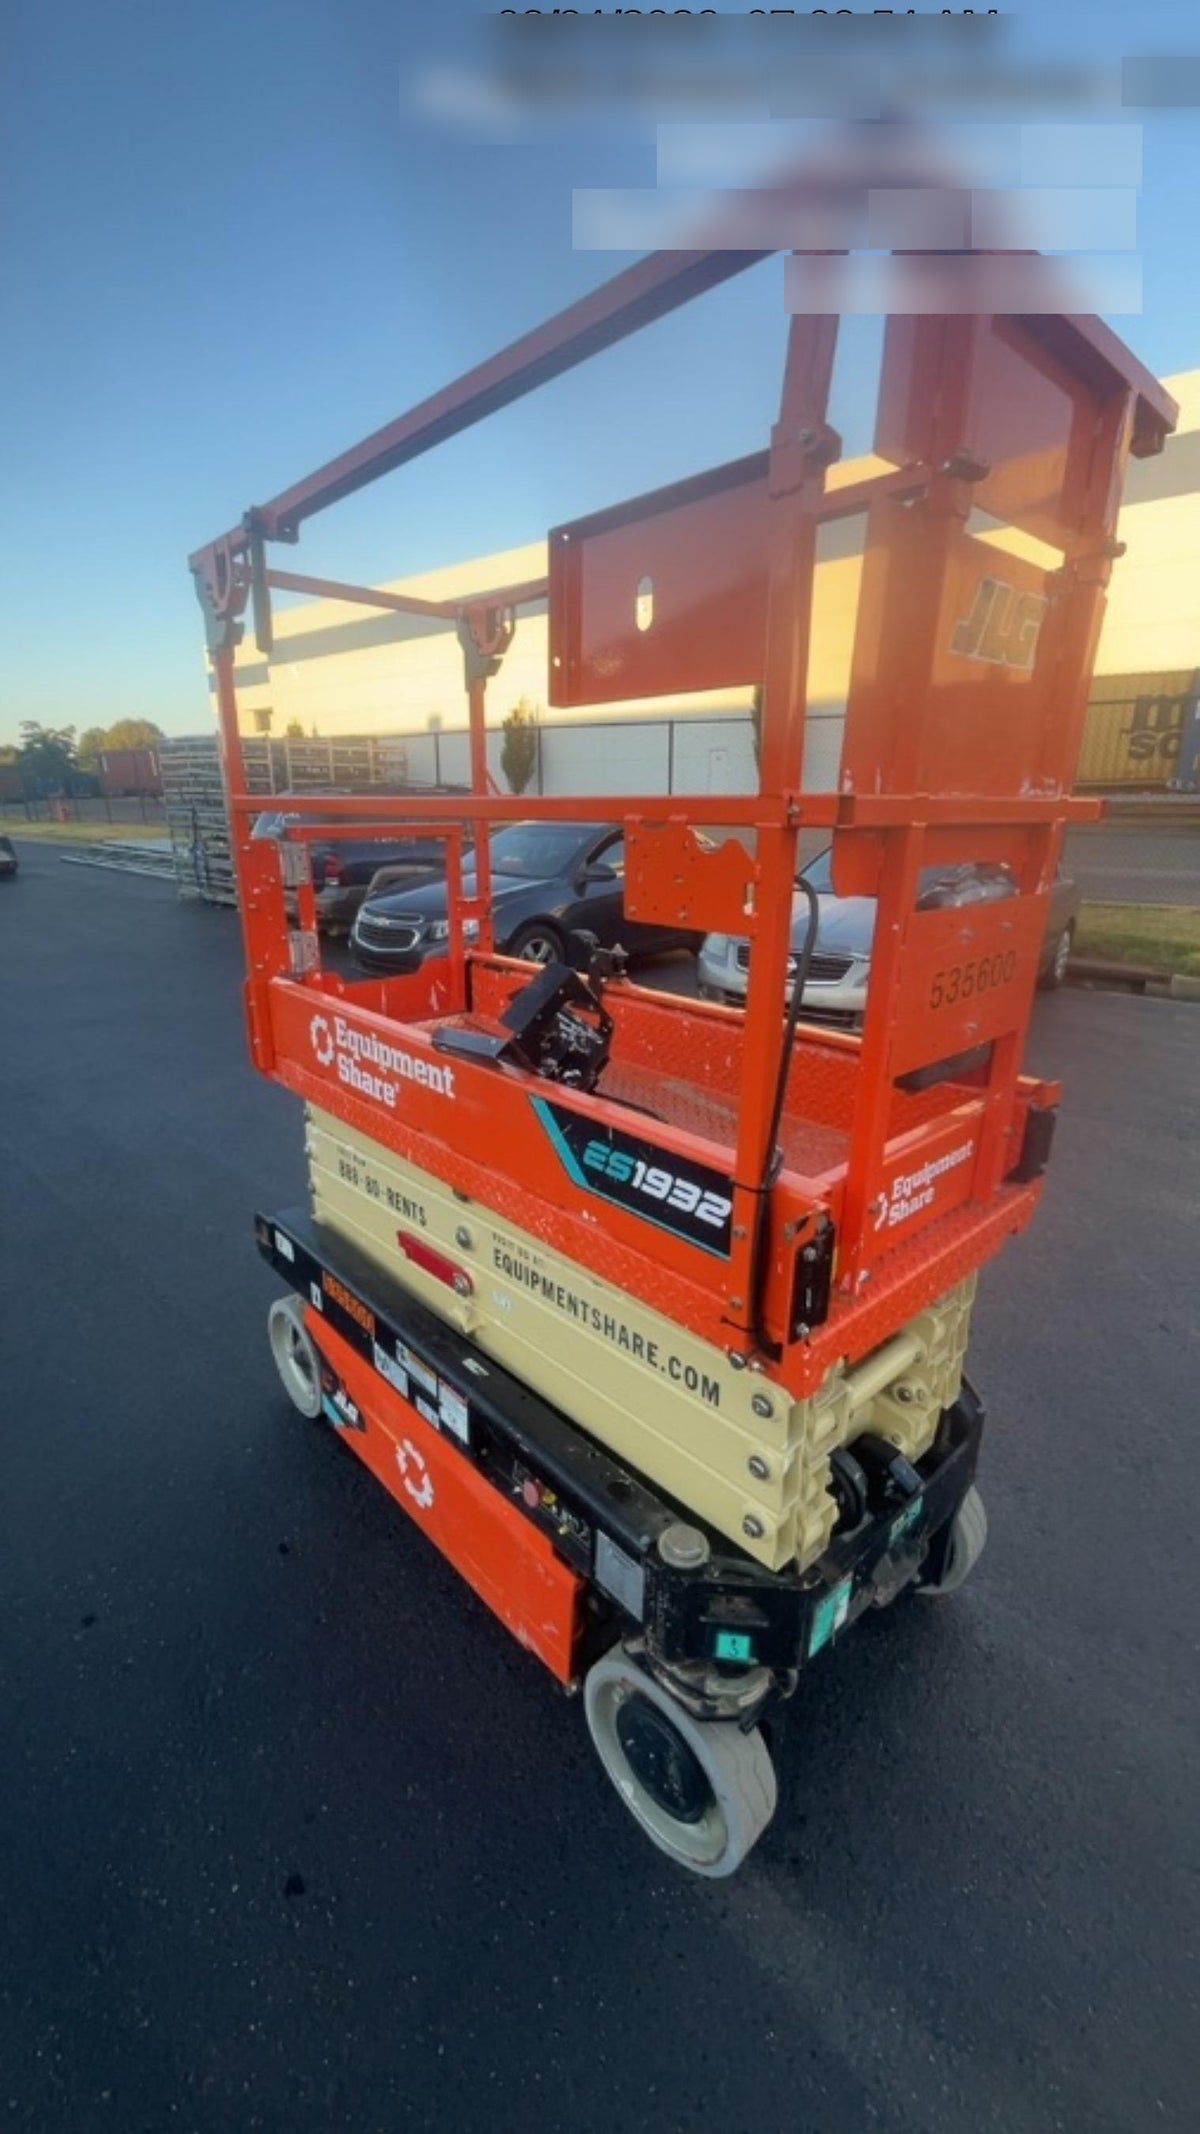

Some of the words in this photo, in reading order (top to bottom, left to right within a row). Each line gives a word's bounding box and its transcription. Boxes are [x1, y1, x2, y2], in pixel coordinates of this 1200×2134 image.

[950, 577, 1048, 668] JLG
[929, 950, 1016, 1009] 535600
[333, 1016, 456, 1098] Equipment
[337, 1055, 397, 1107] Share
[583, 1139, 733, 1228] ES1932
[892, 1139, 974, 1200] Equipment
[888, 1187, 935, 1227] Share
[493, 1247, 720, 1407] EQUIPMENTSHARE.COM
